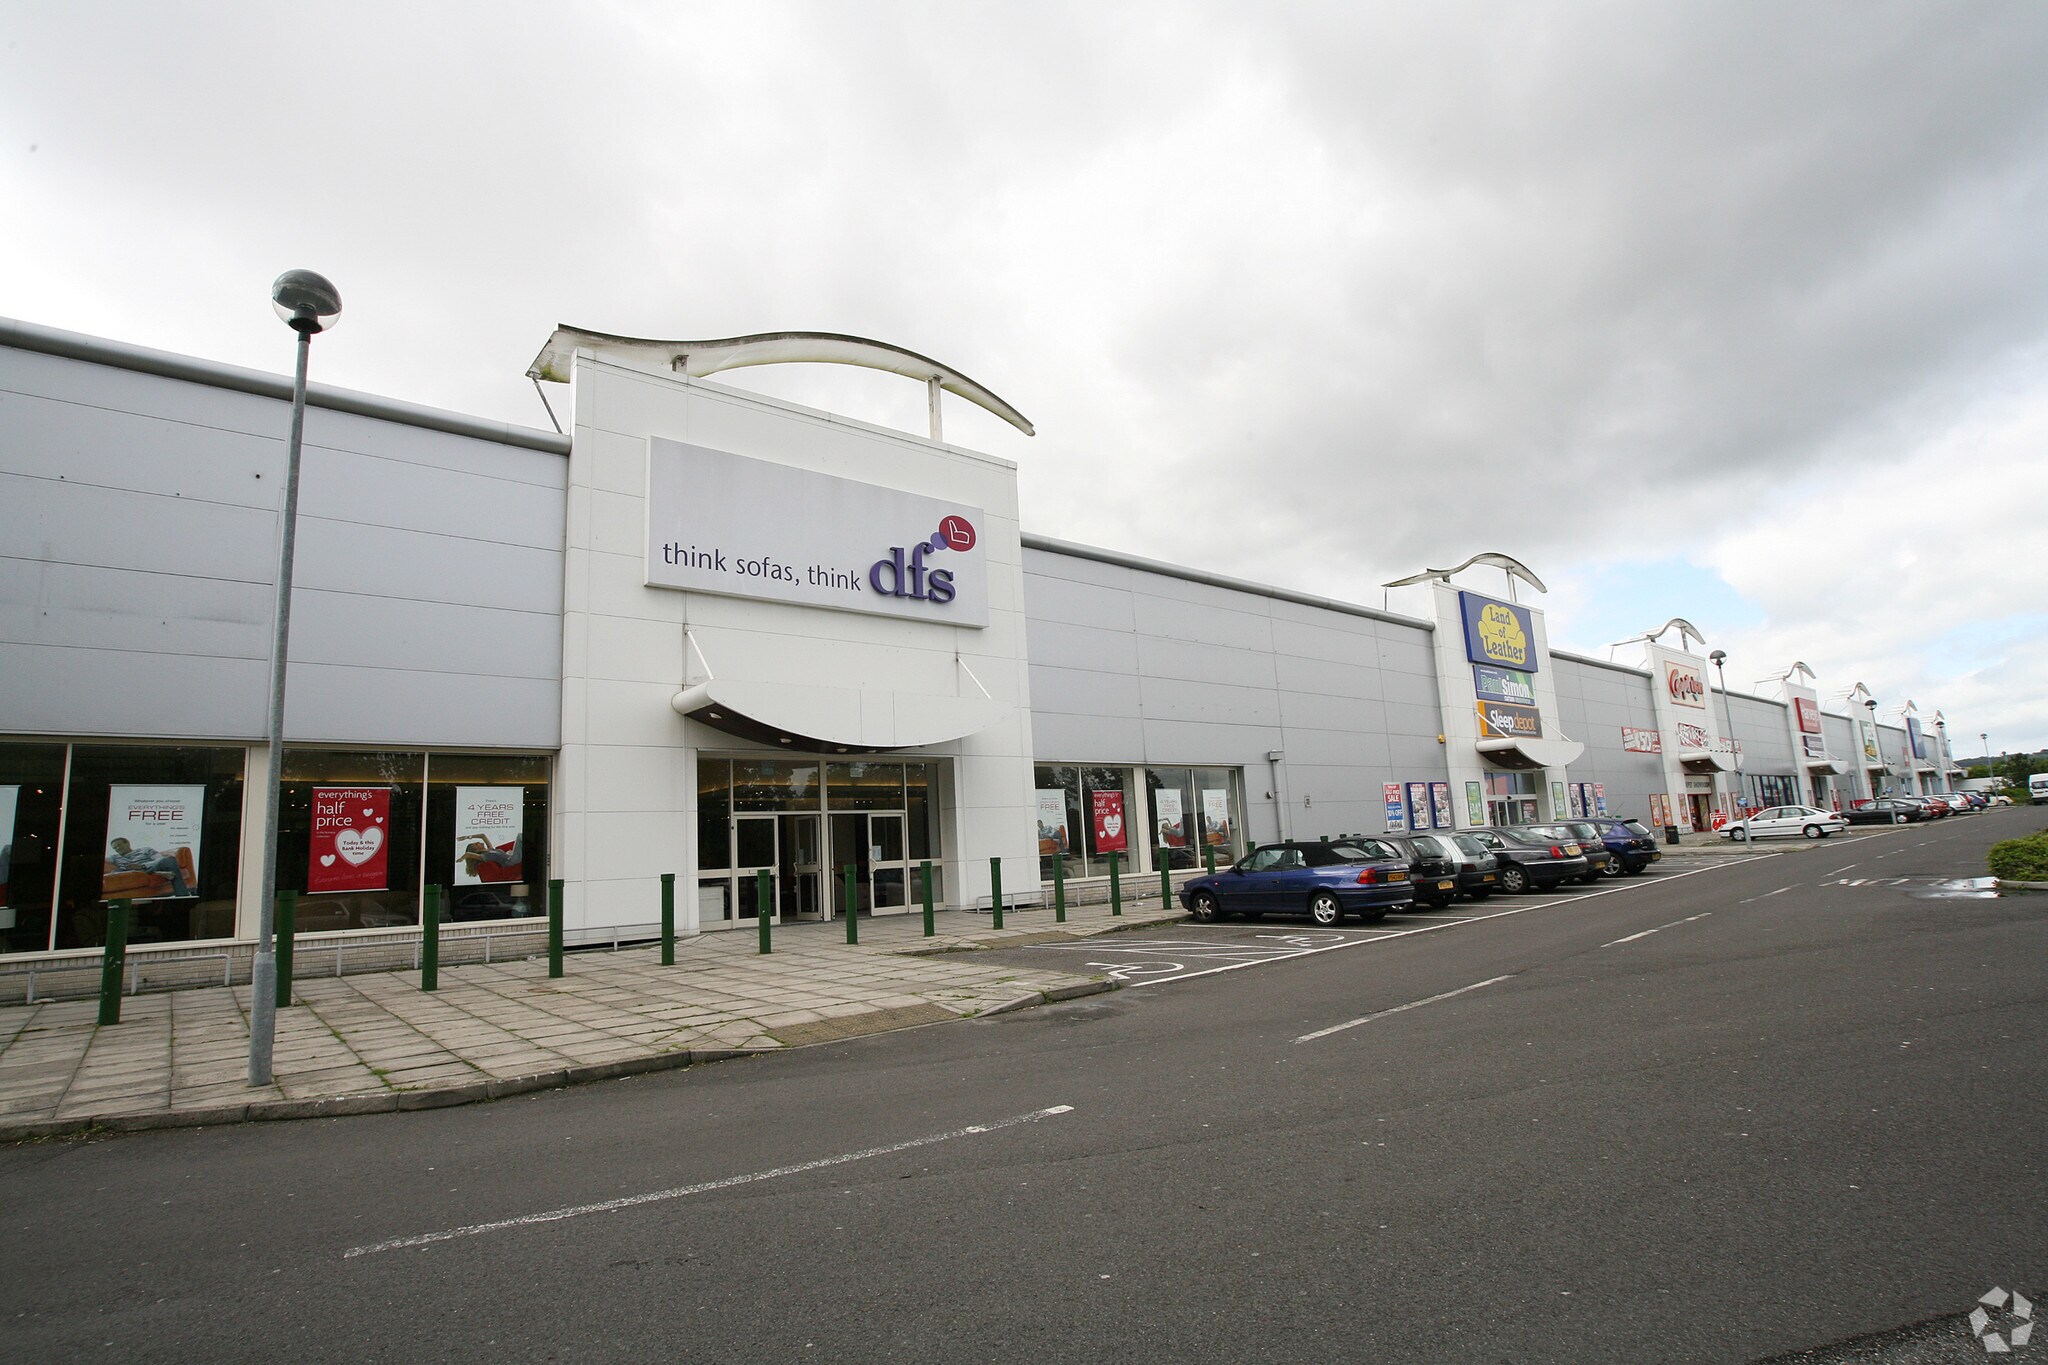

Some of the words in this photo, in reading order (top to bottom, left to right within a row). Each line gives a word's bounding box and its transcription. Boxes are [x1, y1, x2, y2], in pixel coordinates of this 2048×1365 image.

[663, 542, 727, 572] think
[736, 556, 800, 586] sofas,
[808, 565, 861, 591] think
[869, 542, 956, 603] dfs
[1488, 606, 1511, 626] Land
[1498, 626, 1506, 639] of
[1484, 635, 1523, 661] Leather
[318, 790, 373, 801] everything's
[316, 801, 346, 814] half
[477, 803, 514, 811] YEARS
[1094, 799, 1106, 808] half
[128, 810, 184, 821] FREE
[1094, 807, 1110, 816] price
[316, 814, 353, 830] price
[471, 818, 511, 826] CREDIT
